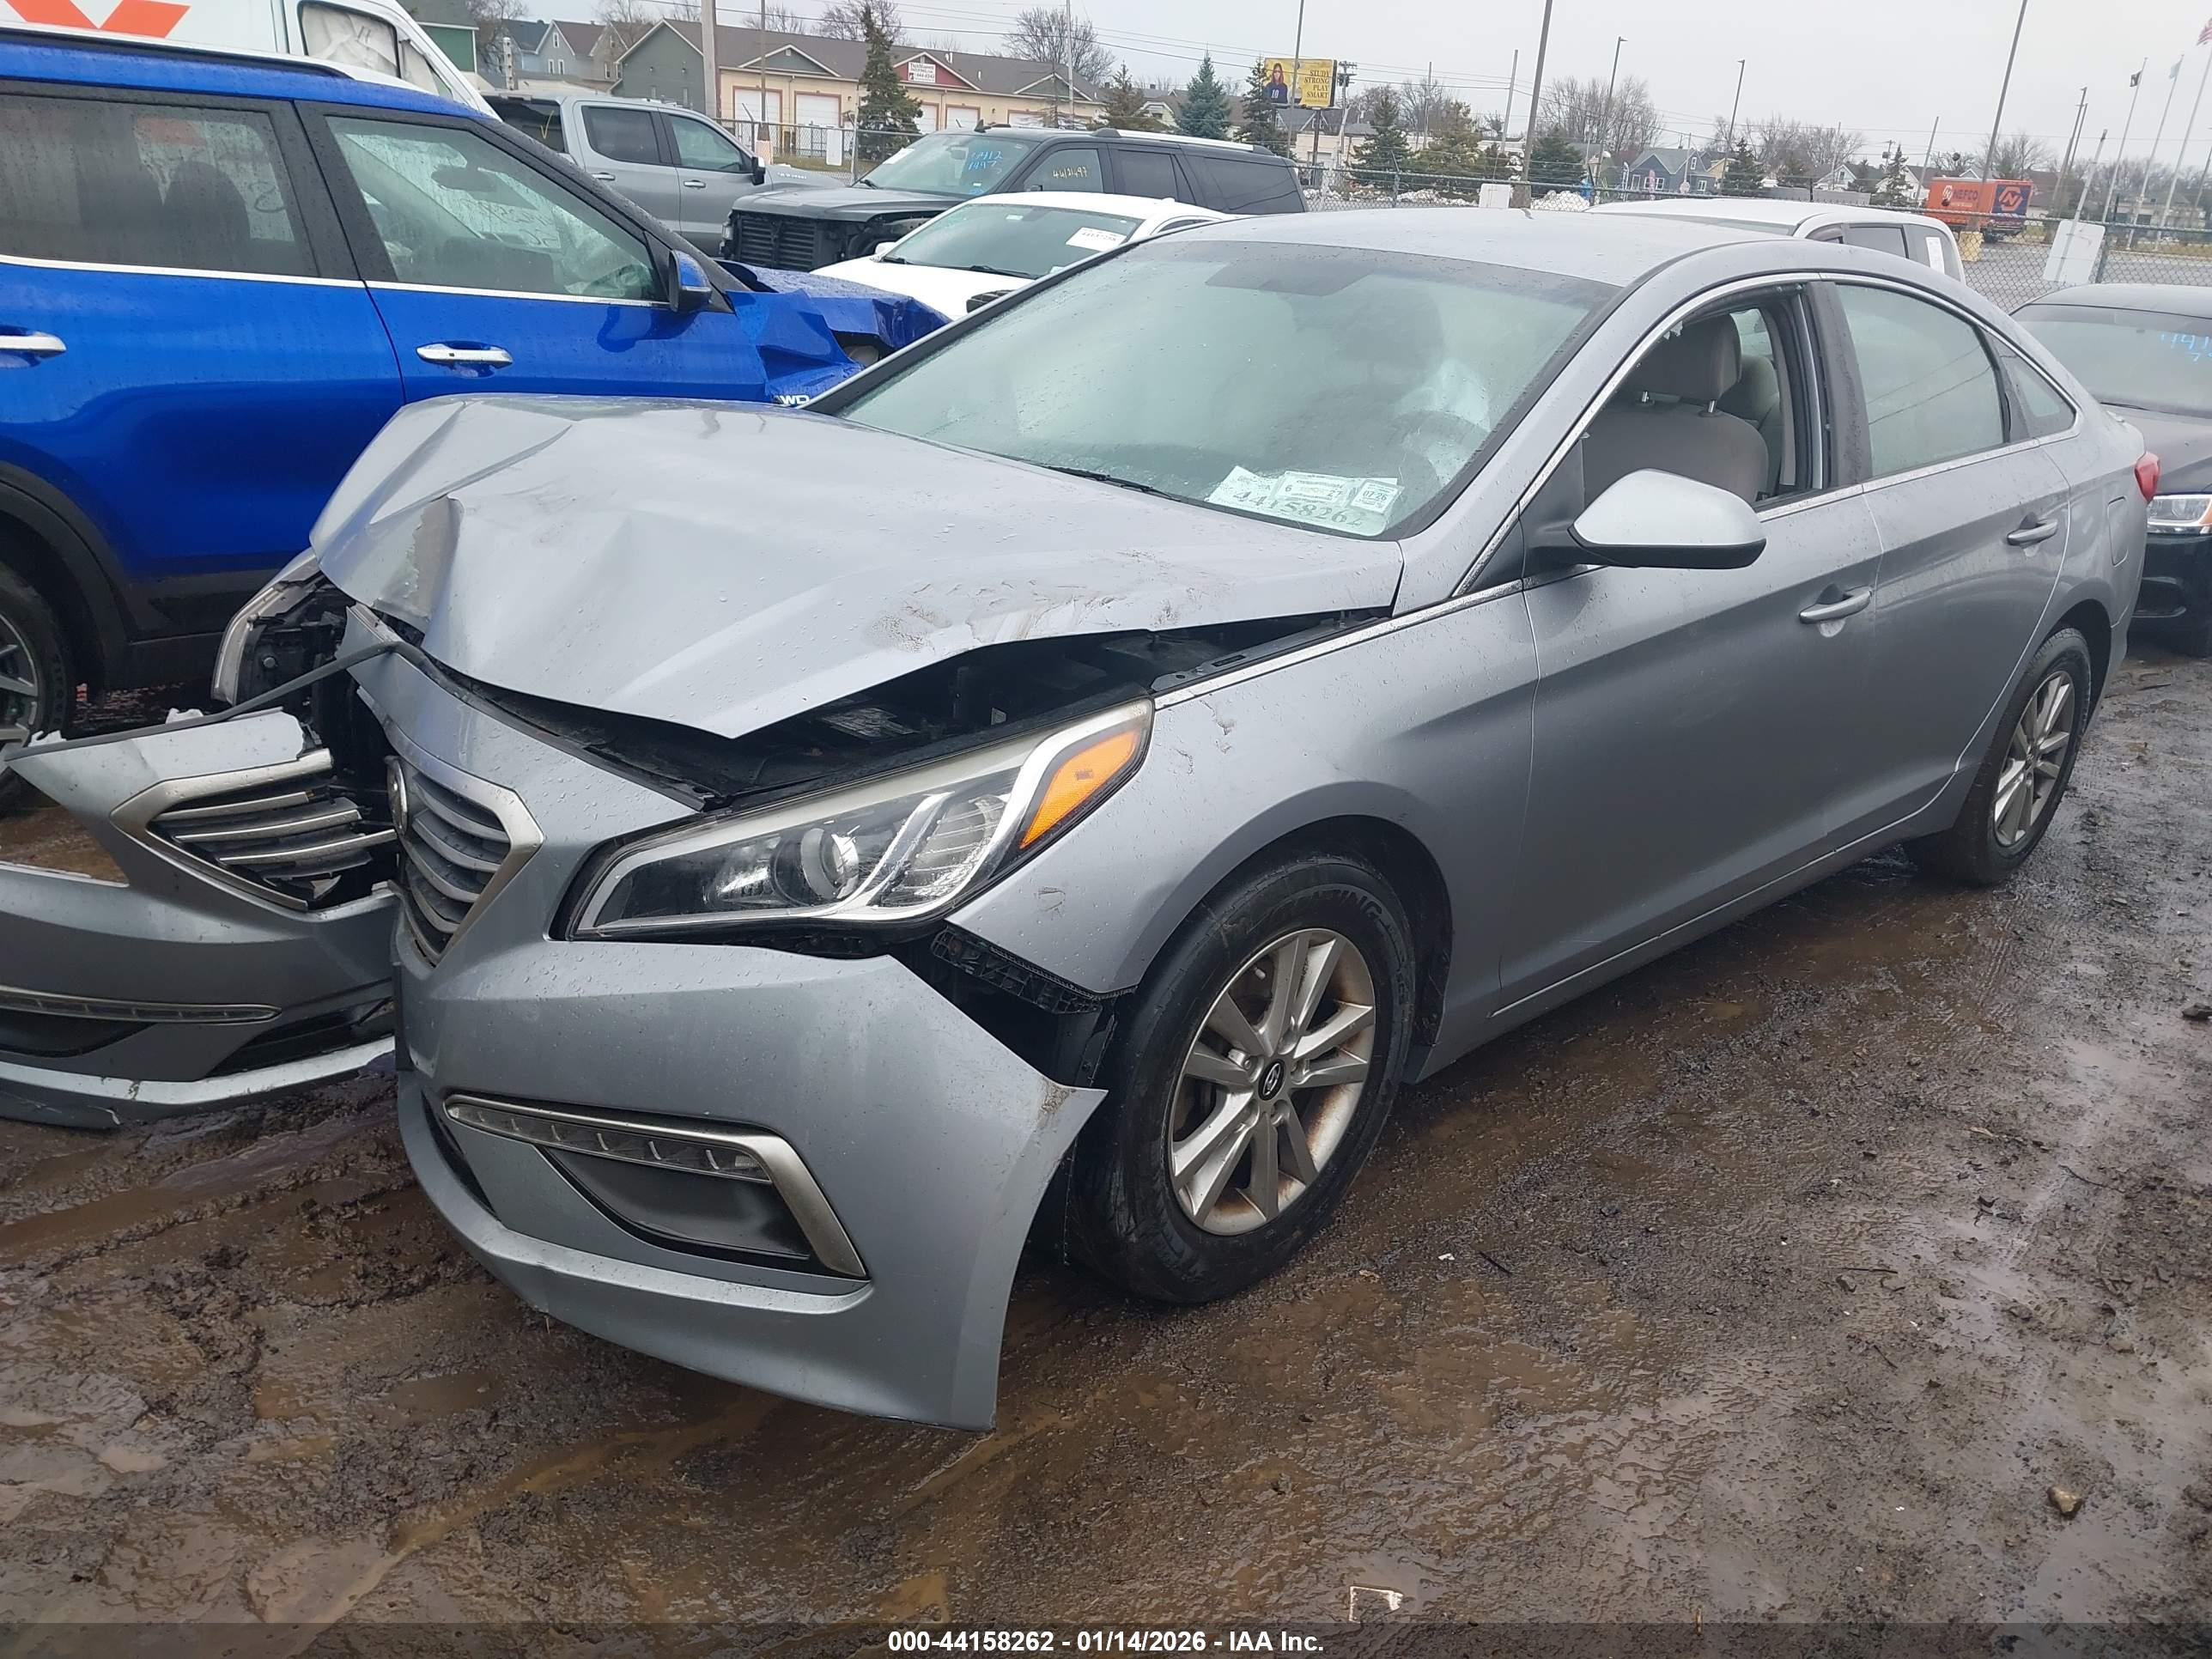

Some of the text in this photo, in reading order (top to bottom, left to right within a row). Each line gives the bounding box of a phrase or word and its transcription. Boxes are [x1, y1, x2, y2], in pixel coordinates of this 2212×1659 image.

[1271, 89, 1279, 99] 10
[1952, 189, 1978, 201] NEFCO
[1285, 484, 1293, 493] 6
[1363, 489, 1389, 501] 07 26
